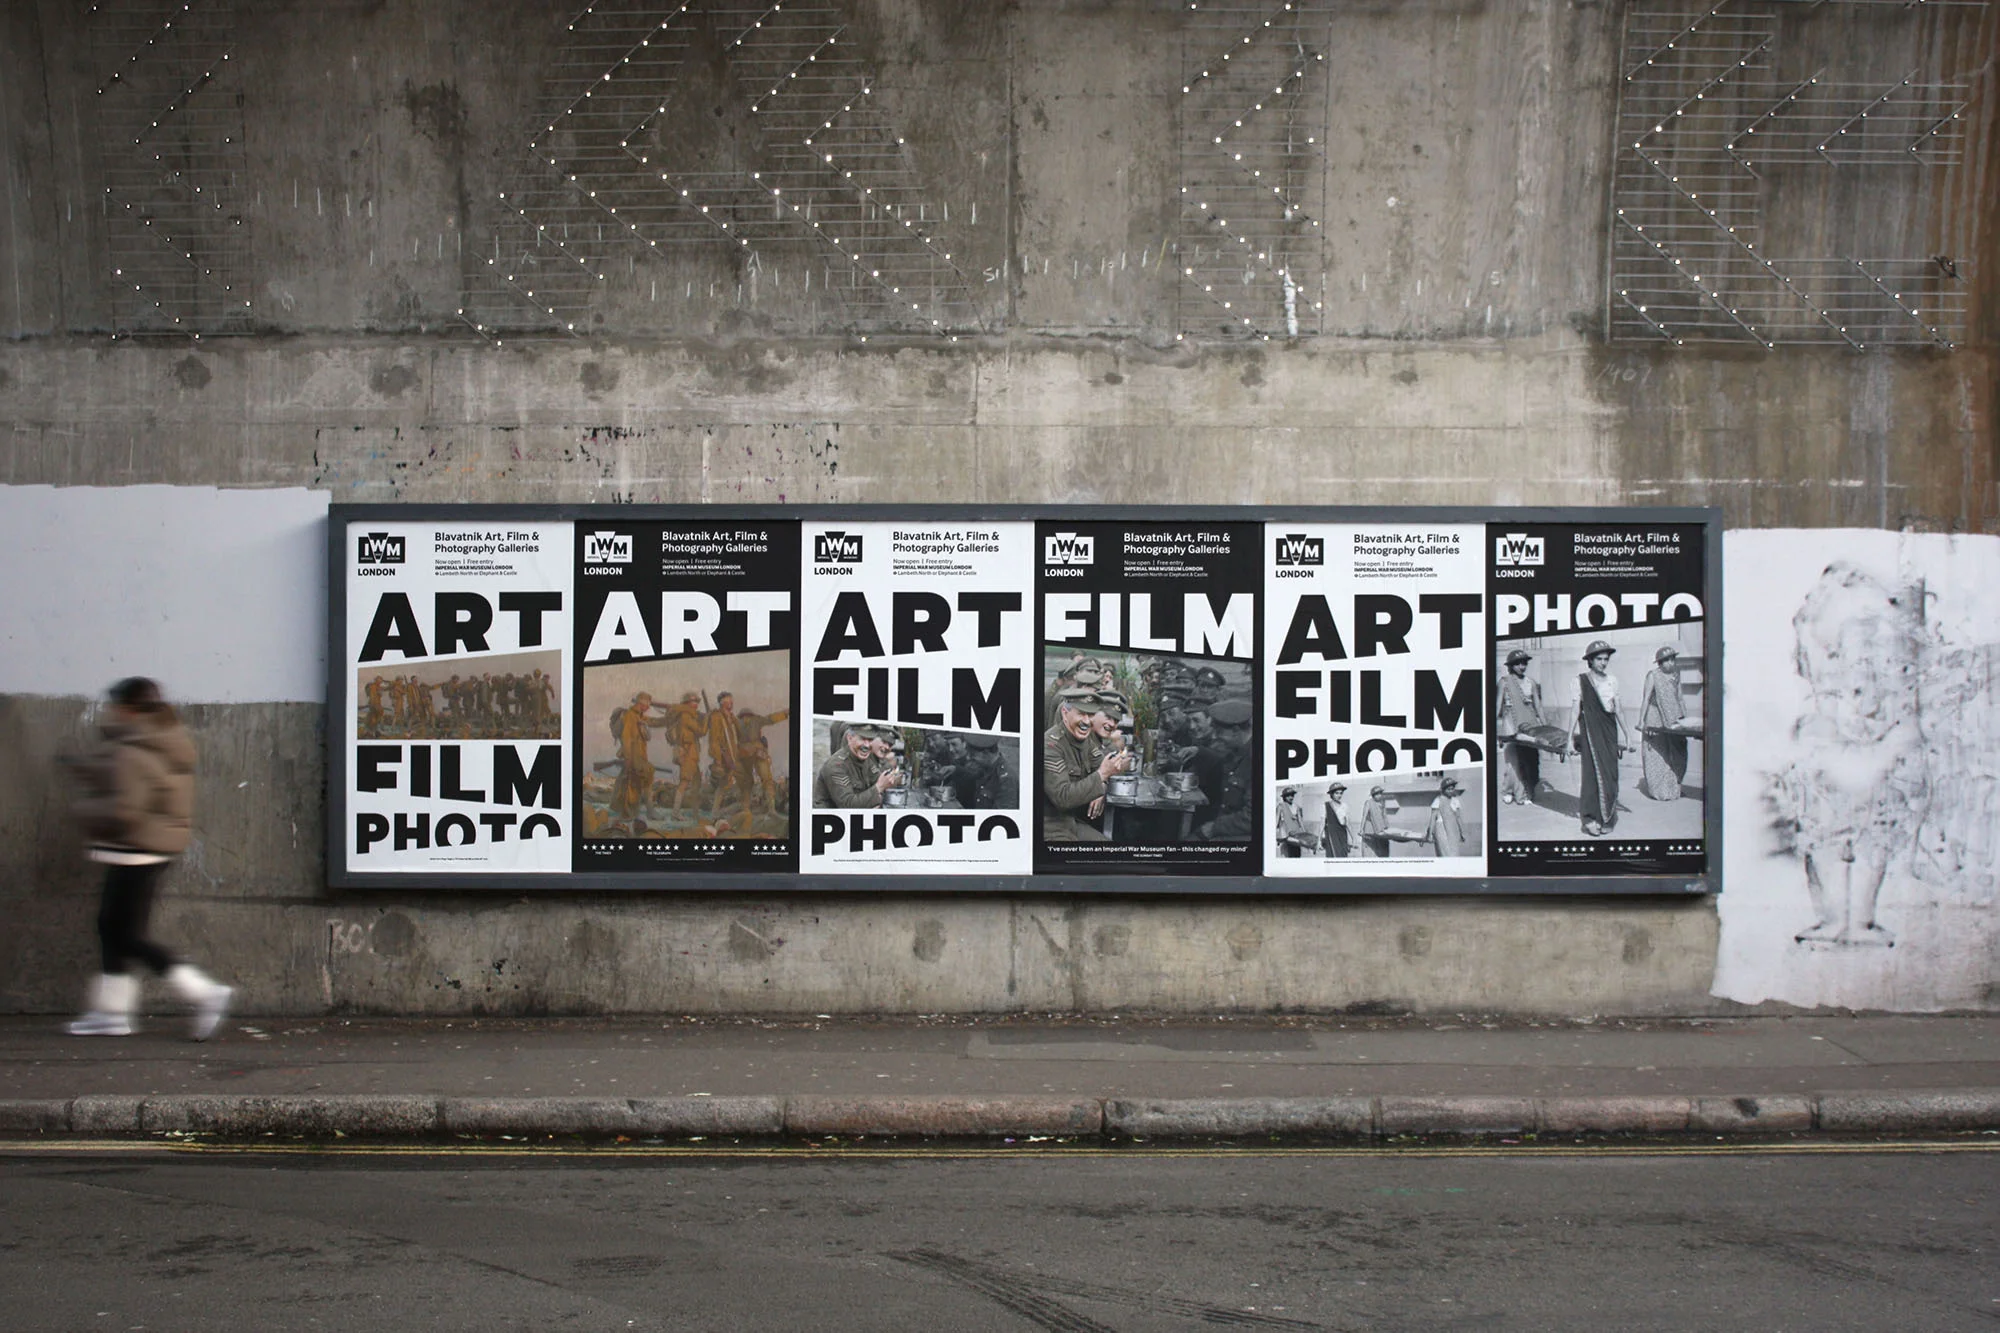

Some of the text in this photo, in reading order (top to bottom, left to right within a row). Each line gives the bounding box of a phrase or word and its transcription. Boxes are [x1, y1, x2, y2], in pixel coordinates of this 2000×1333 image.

[434, 532, 540, 541] Blavatnik Art, Film &
[662, 531, 768, 541] Blavatnik Art, Film &
[893, 531, 1000, 541] Blavatnik Art, Film &
[1123, 532, 1231, 542] Blavatnik Art, Film &
[1354, 534, 1460, 543] Blavatnik Art, Film &
[1574, 533, 1680, 543] Blavatnik Art, Film &
[364, 539, 401, 557] IWM
[434, 543, 540, 555] Photography Galleries
[591, 538, 628, 556] IWM
[662, 543, 768, 554] Photography Galleries
[821, 538, 858, 556] IWM
[893, 543, 1000, 554] Photography Galleries
[1051, 540, 1089, 557] IWM
[1123, 544, 1231, 555] Photography Galleries
[1282, 541, 1319, 558] IWM
[1354, 545, 1460, 556] Photography Galleries
[1502, 540, 1539, 557] IWM
[1574, 545, 1680, 556] Photography Galleries
[358, 568, 396, 576] LONDON
[584, 567, 623, 575] LONDON
[814, 567, 853, 575] LONDON
[1045, 569, 1083, 577] LONDON
[1275, 570, 1314, 578] LONDON
[1495, 570, 1535, 578] LONDON
[1496, 593, 1704, 637] PHOTO
[358, 592, 562, 662] ART
[584, 592, 790, 661] ART
[815, 592, 1021, 662] ART
[1045, 593, 1253, 658] FILM
[1276, 594, 1482, 665] ART
[813, 668, 1020, 732] FILM
[1276, 670, 1482, 734] FILM
[1276, 739, 1482, 780] PHOTO
[357, 745, 562, 809] FILM
[357, 813, 562, 855] PHOTO
[812, 815, 1020, 855] PHOTO
